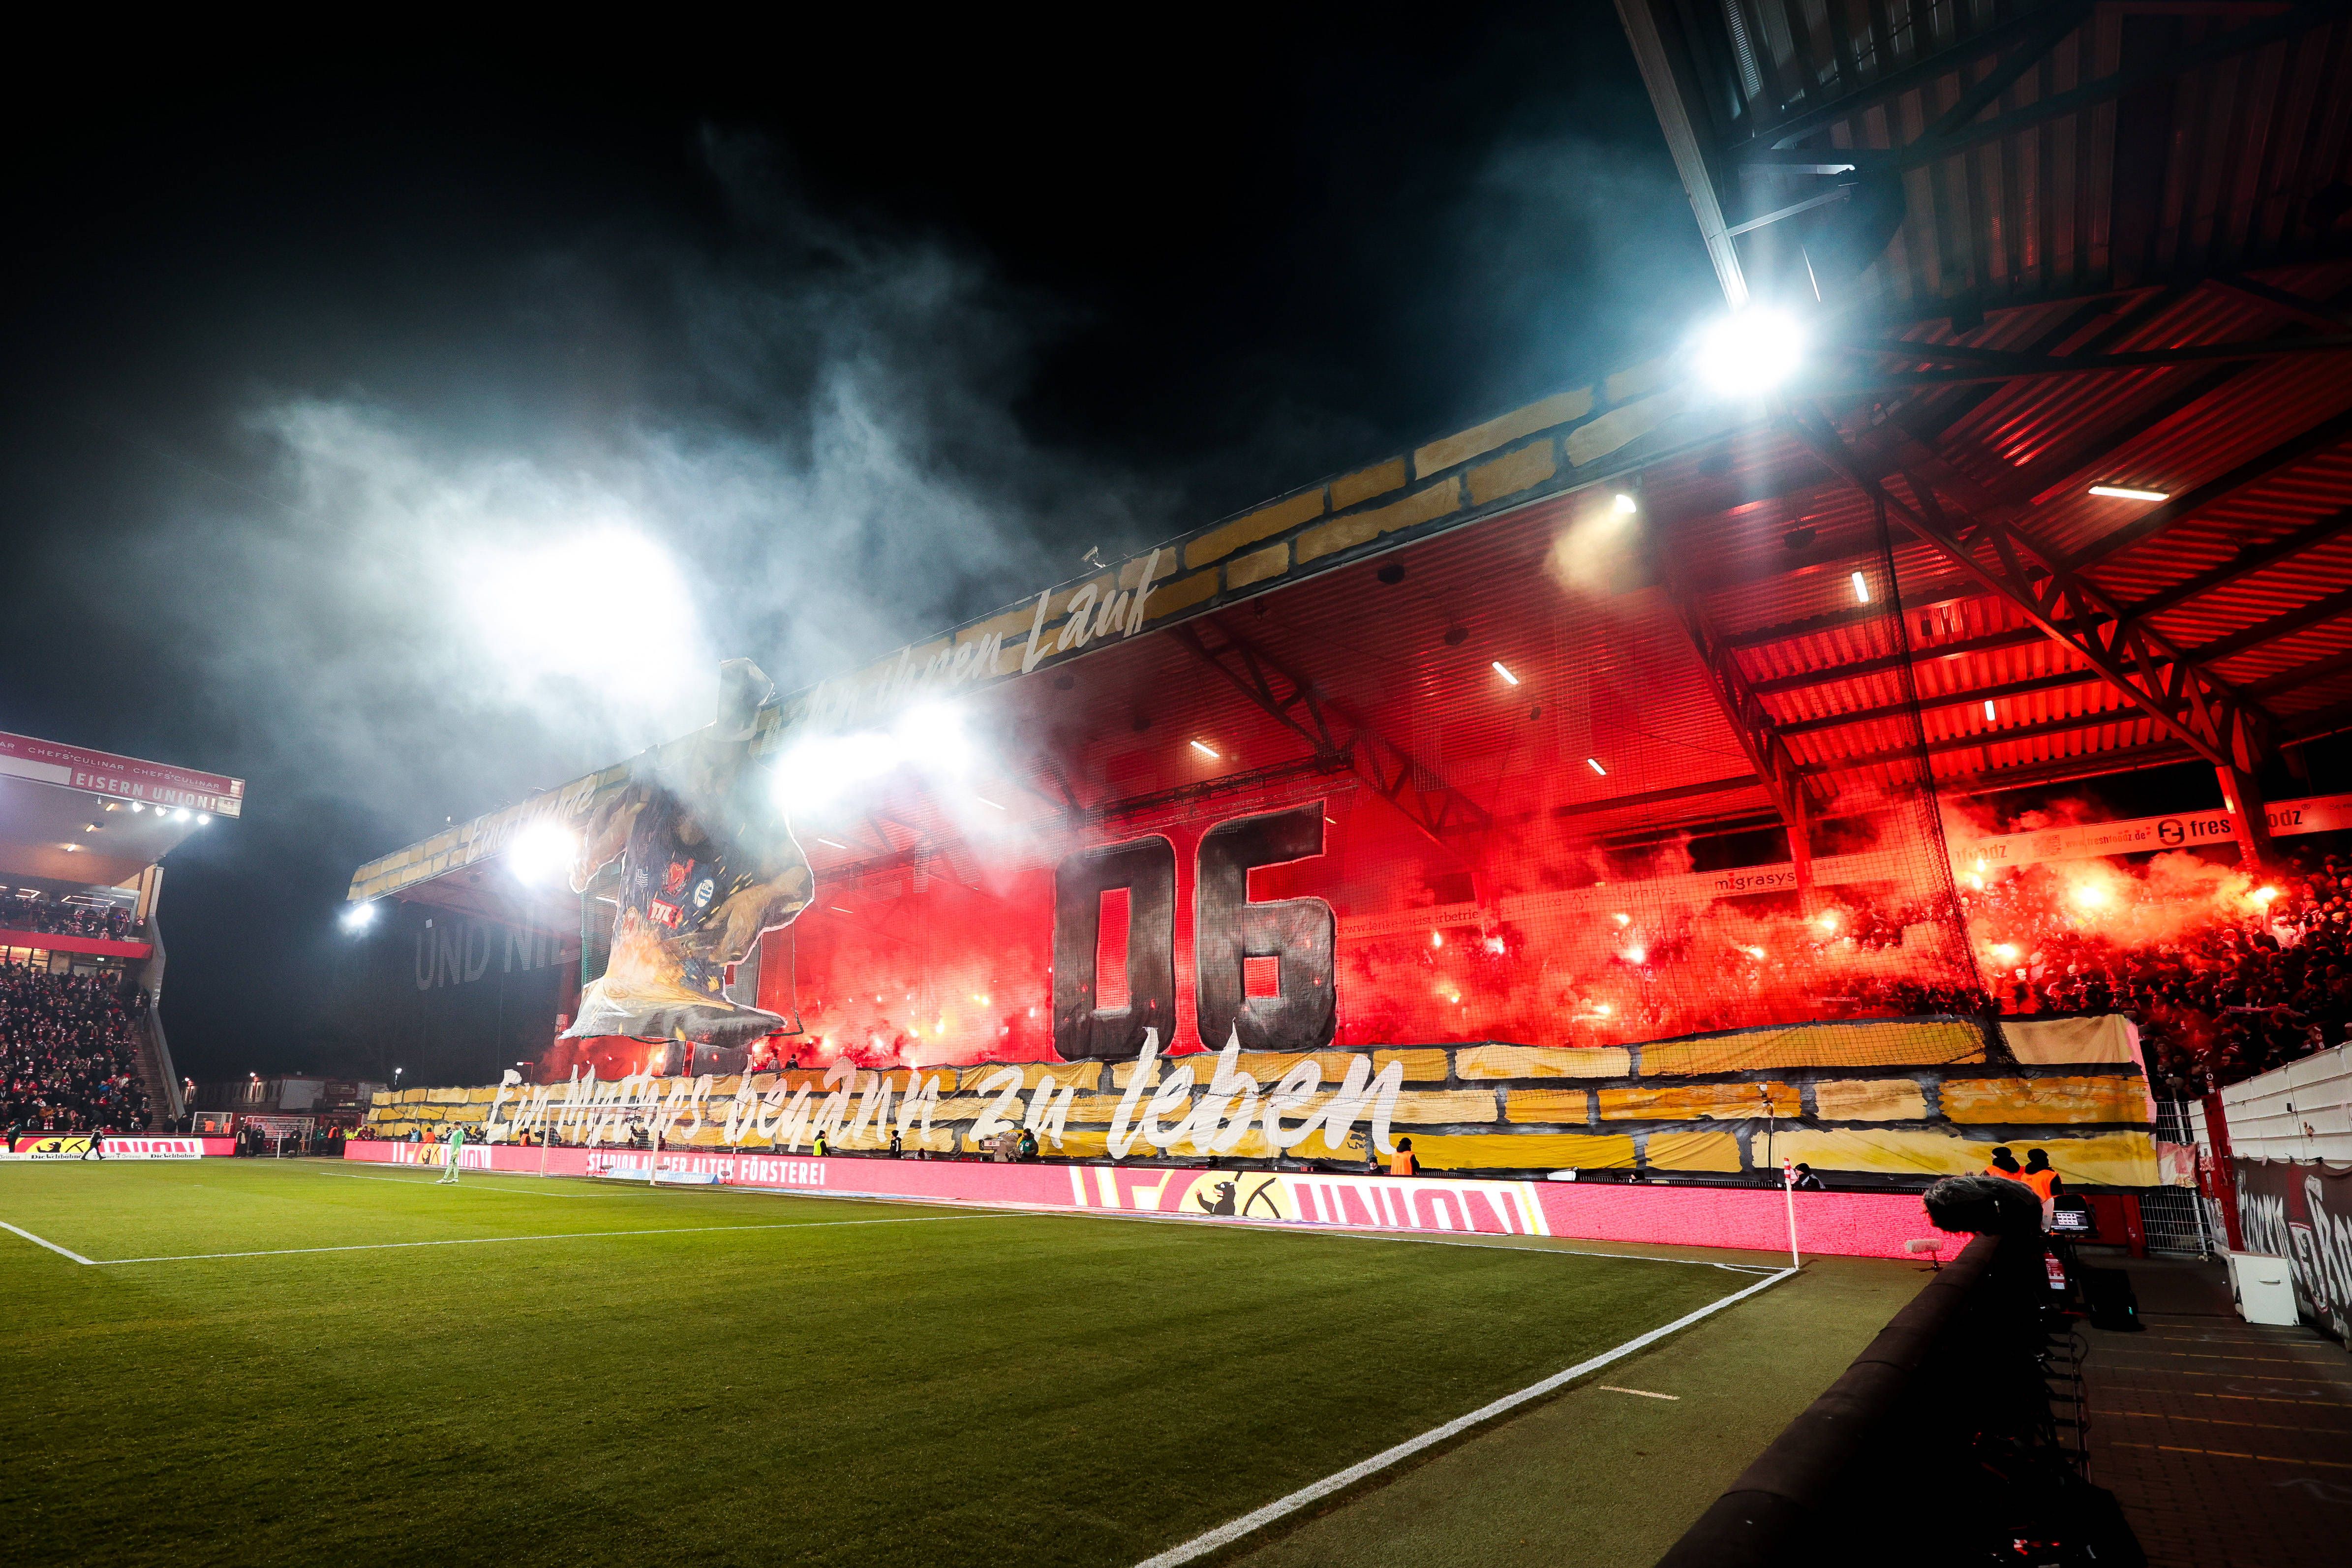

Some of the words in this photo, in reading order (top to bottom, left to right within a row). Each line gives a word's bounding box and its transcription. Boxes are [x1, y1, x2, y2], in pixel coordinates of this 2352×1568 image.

[1022, 548, 1160, 670] Lauf
[76, 772, 143, 797] EISERN
[153, 790, 216, 810] UNION!
[1714, 871, 1795, 891] migrasys
[415, 919, 490, 991] UND
[1052, 798, 1339, 1063] 06
[486, 1069, 549, 1144] Ein
[556, 1061, 713, 1147] Mythos
[724, 1054, 941, 1152] begann
[970, 1066, 1074, 1149] zu
[1106, 1017, 1407, 1159] leben
[588, 1153, 637, 1171] STADION
[740, 1156, 825, 1185] FÖRSTEREI
